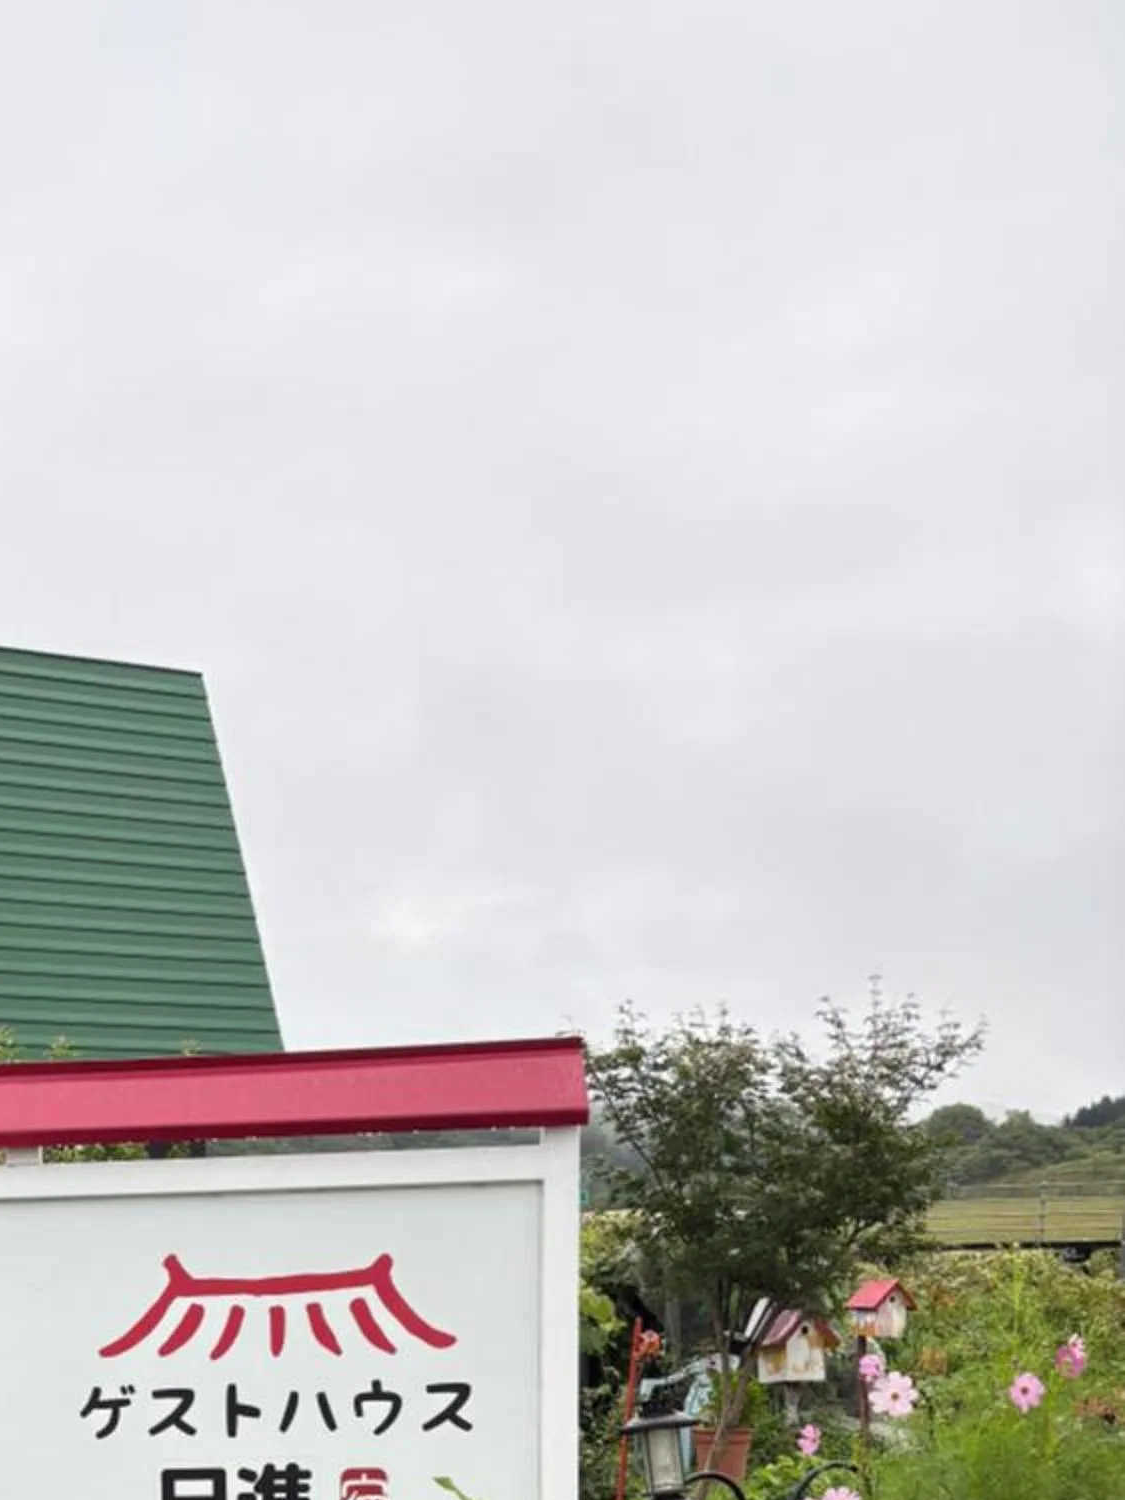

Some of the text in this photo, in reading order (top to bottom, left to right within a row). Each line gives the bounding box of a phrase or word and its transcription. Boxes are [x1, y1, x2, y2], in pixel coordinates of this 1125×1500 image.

[79, 1379, 474, 1440] ゲストハウス
